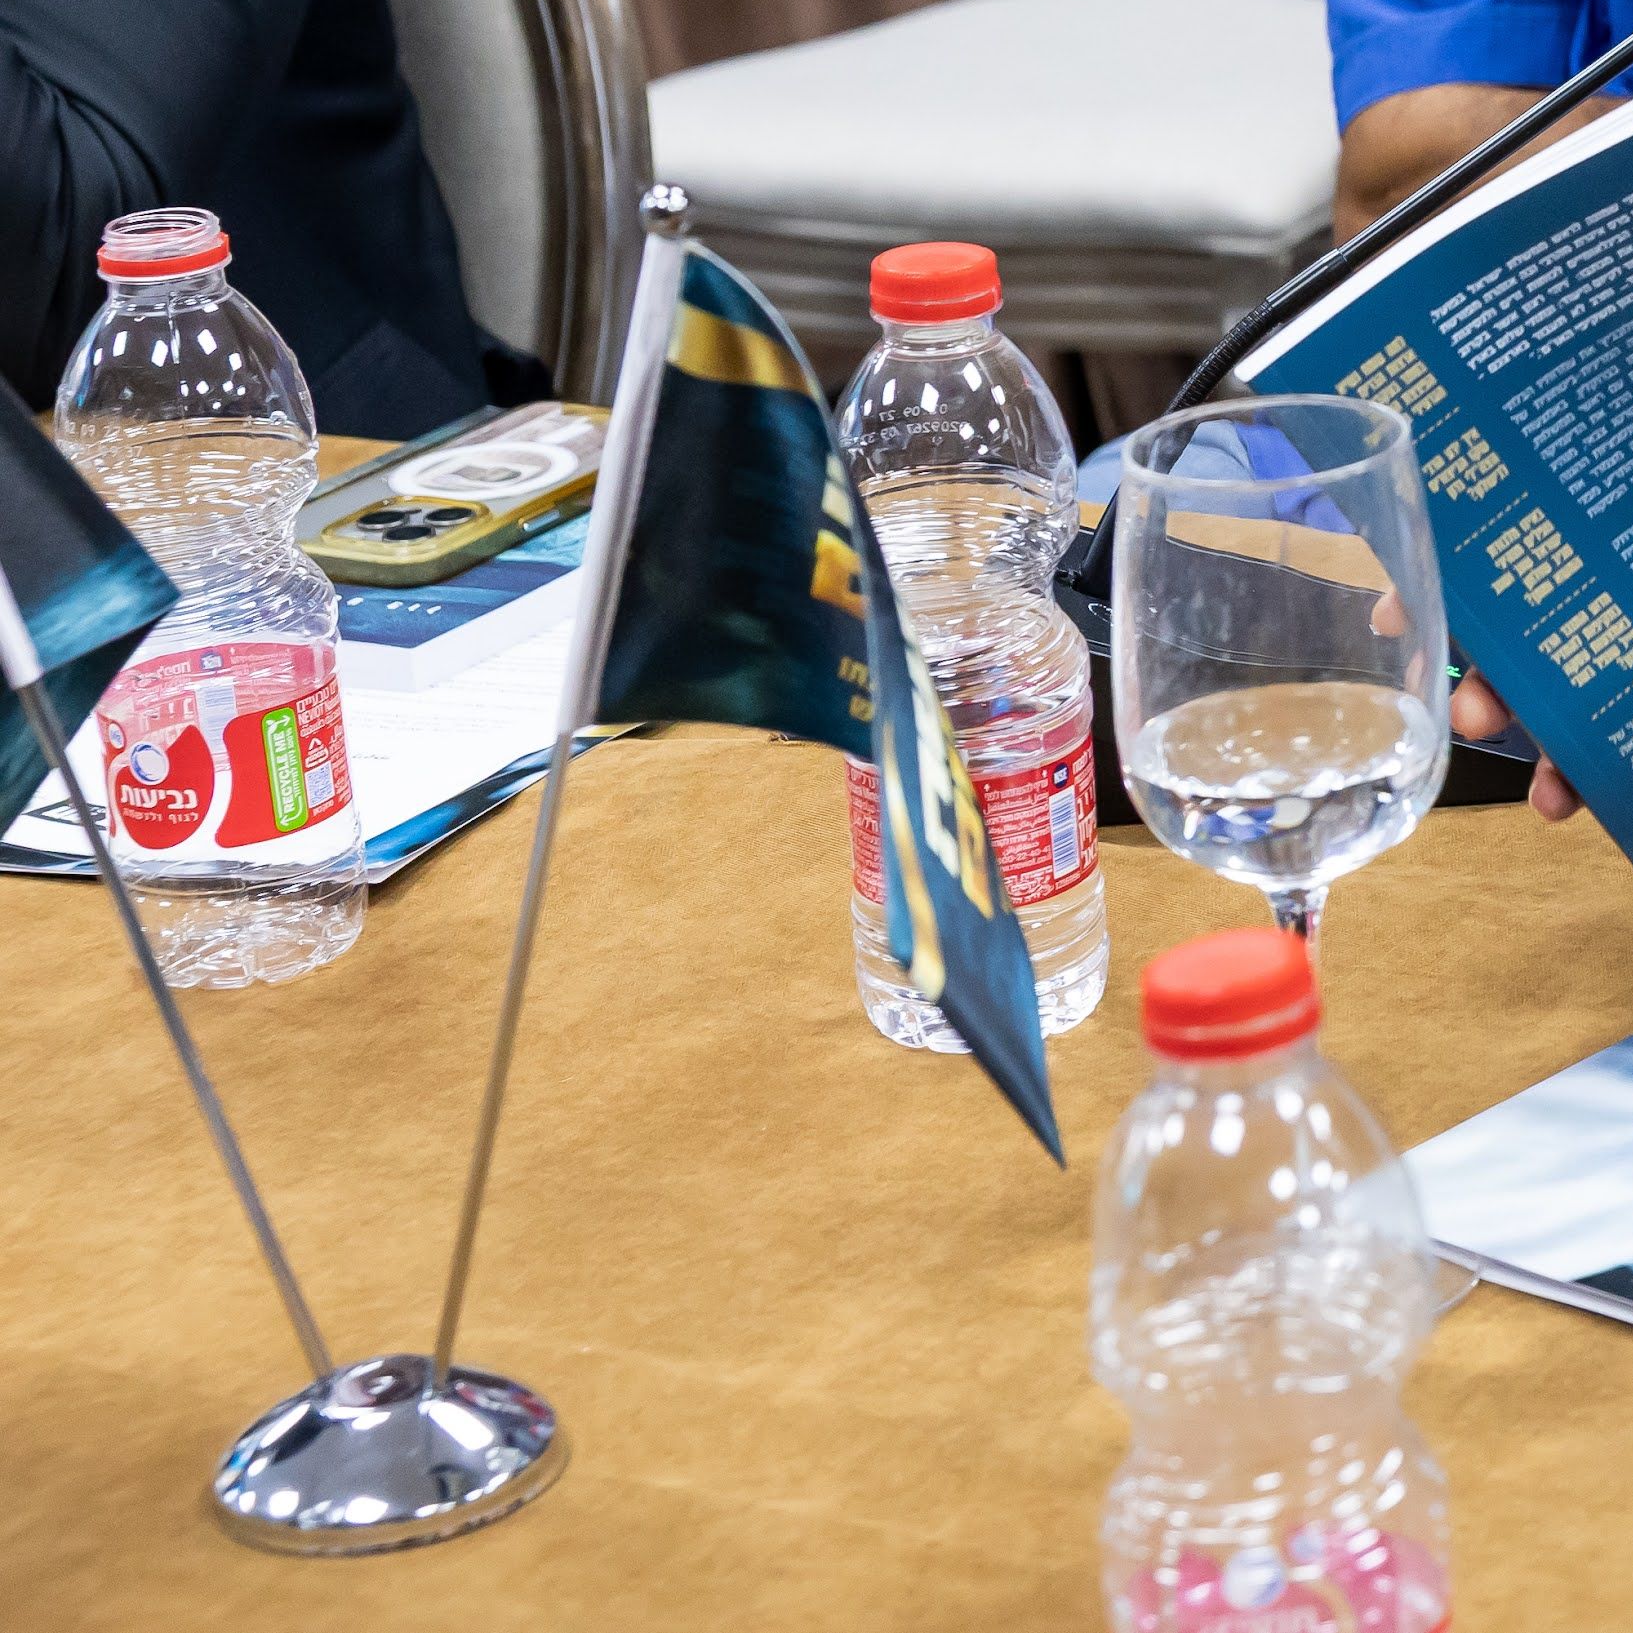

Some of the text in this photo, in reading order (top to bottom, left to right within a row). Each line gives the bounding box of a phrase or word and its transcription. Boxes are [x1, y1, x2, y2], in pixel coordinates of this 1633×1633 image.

[121, 782, 200, 810] נביעות
[272, 729, 295, 814] RECYCLE ME
